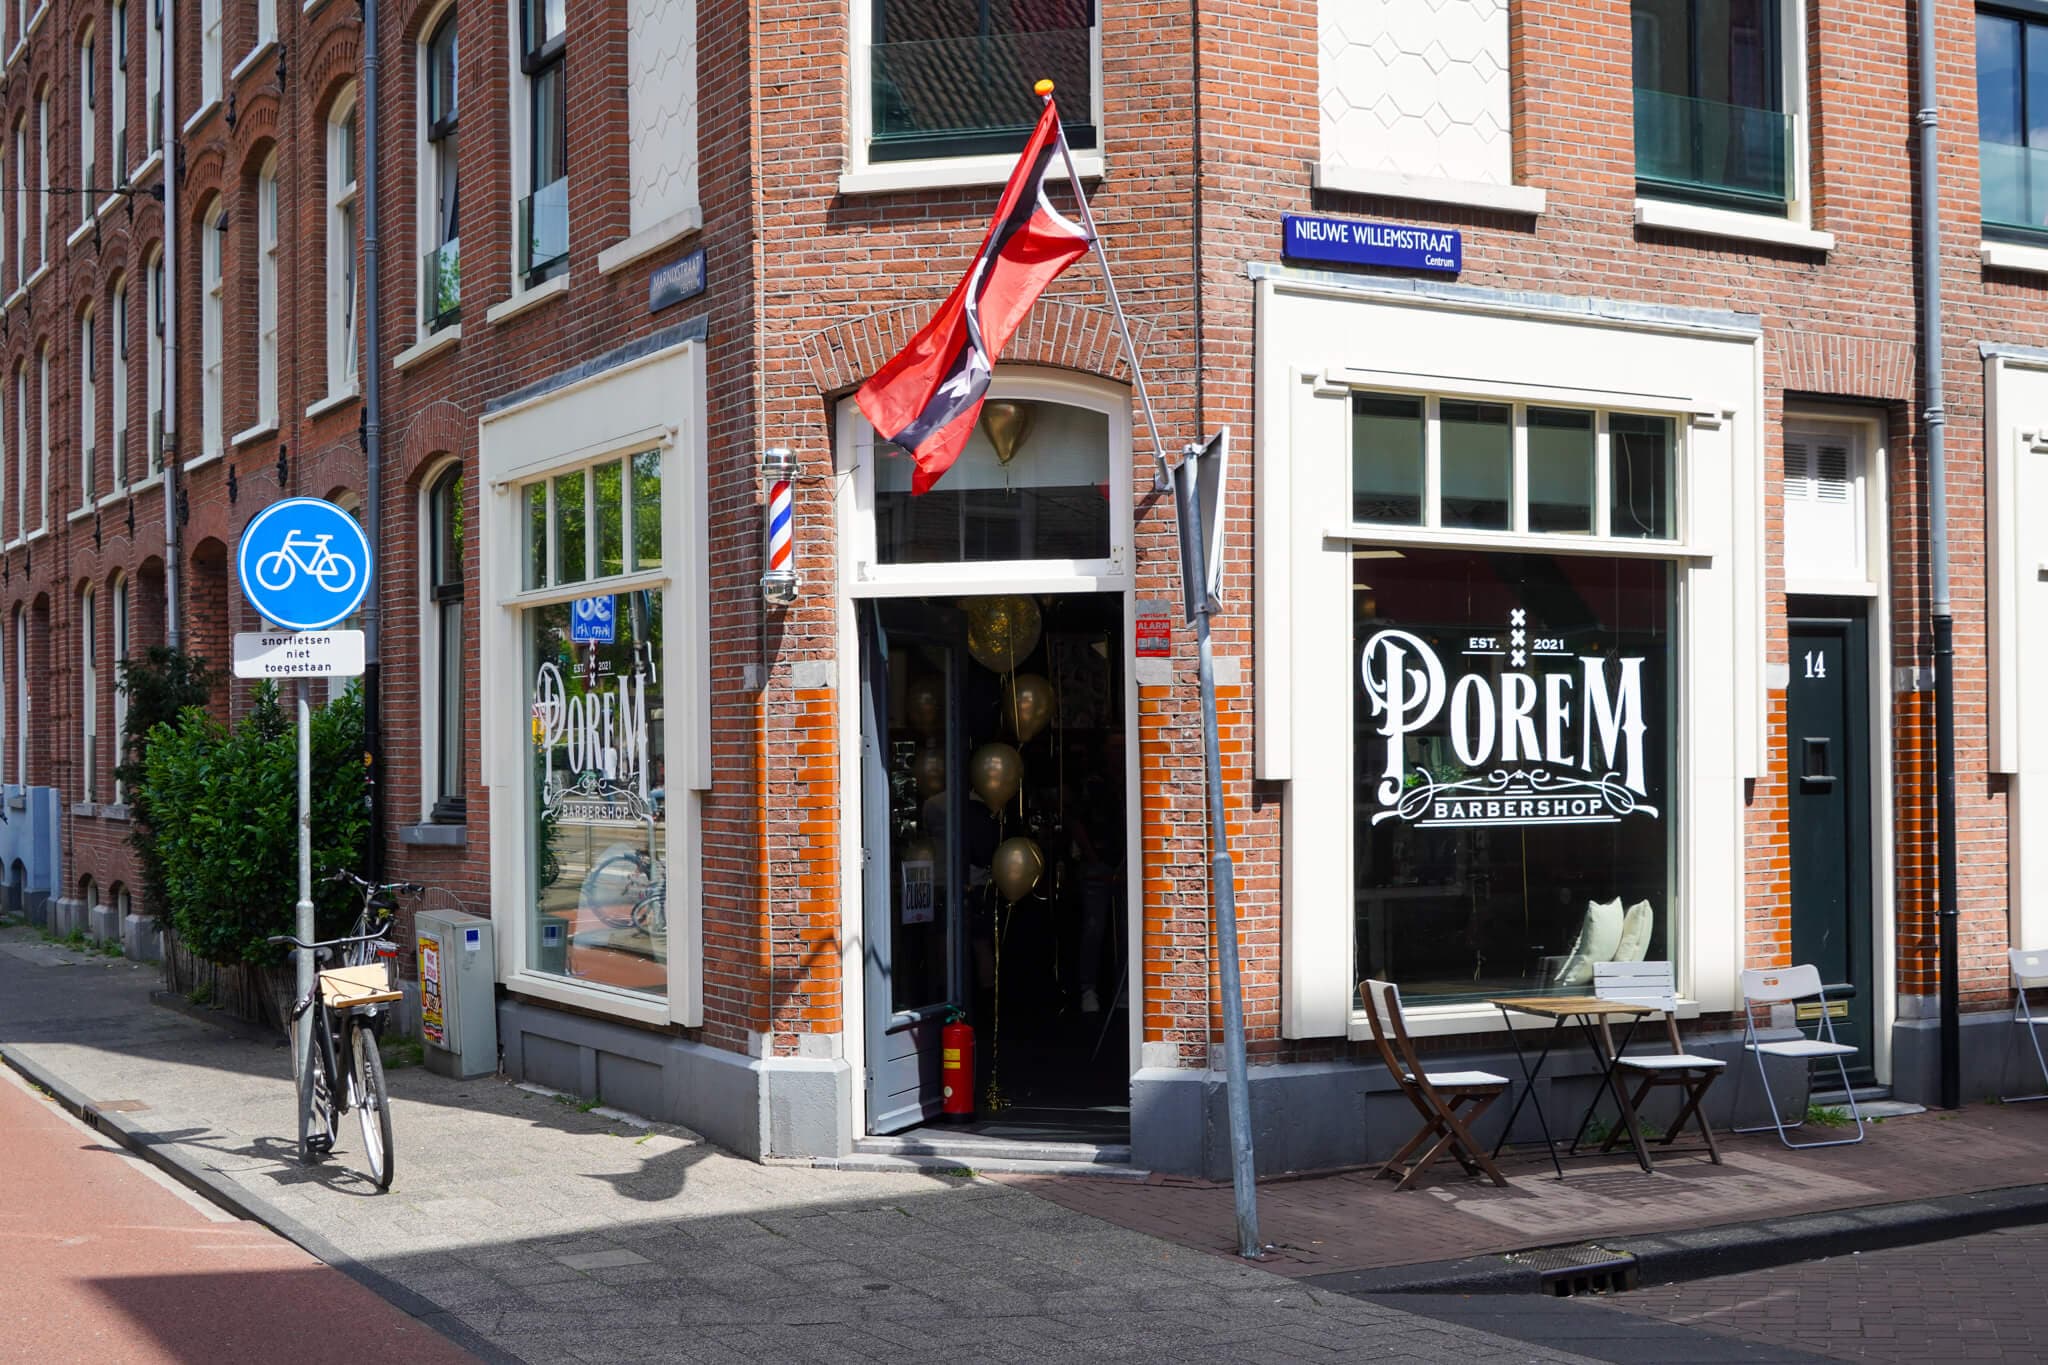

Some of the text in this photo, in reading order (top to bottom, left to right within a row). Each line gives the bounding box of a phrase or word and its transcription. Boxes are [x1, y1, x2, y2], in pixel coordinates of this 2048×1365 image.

[1295, 220, 1454, 253] NIEUWE WILLEMSSTRAAT
[1425, 254, 1455, 267] Centrum
[653, 256, 700, 289] MARNIXSTRAAT
[1138, 621, 1169, 630] ALARM
[261, 636, 330, 646] snorfietsen
[1469, 638, 1565, 650] EST. 2021
[286, 649, 310, 658] niet
[265, 663, 332, 674] toegestaan
[573, 661, 611, 673] EST. 2021
[1804, 650, 1826, 678] 14
[562, 804, 629, 820] BARBERSHOP
[1434, 800, 1603, 818] BARBERSHOP
